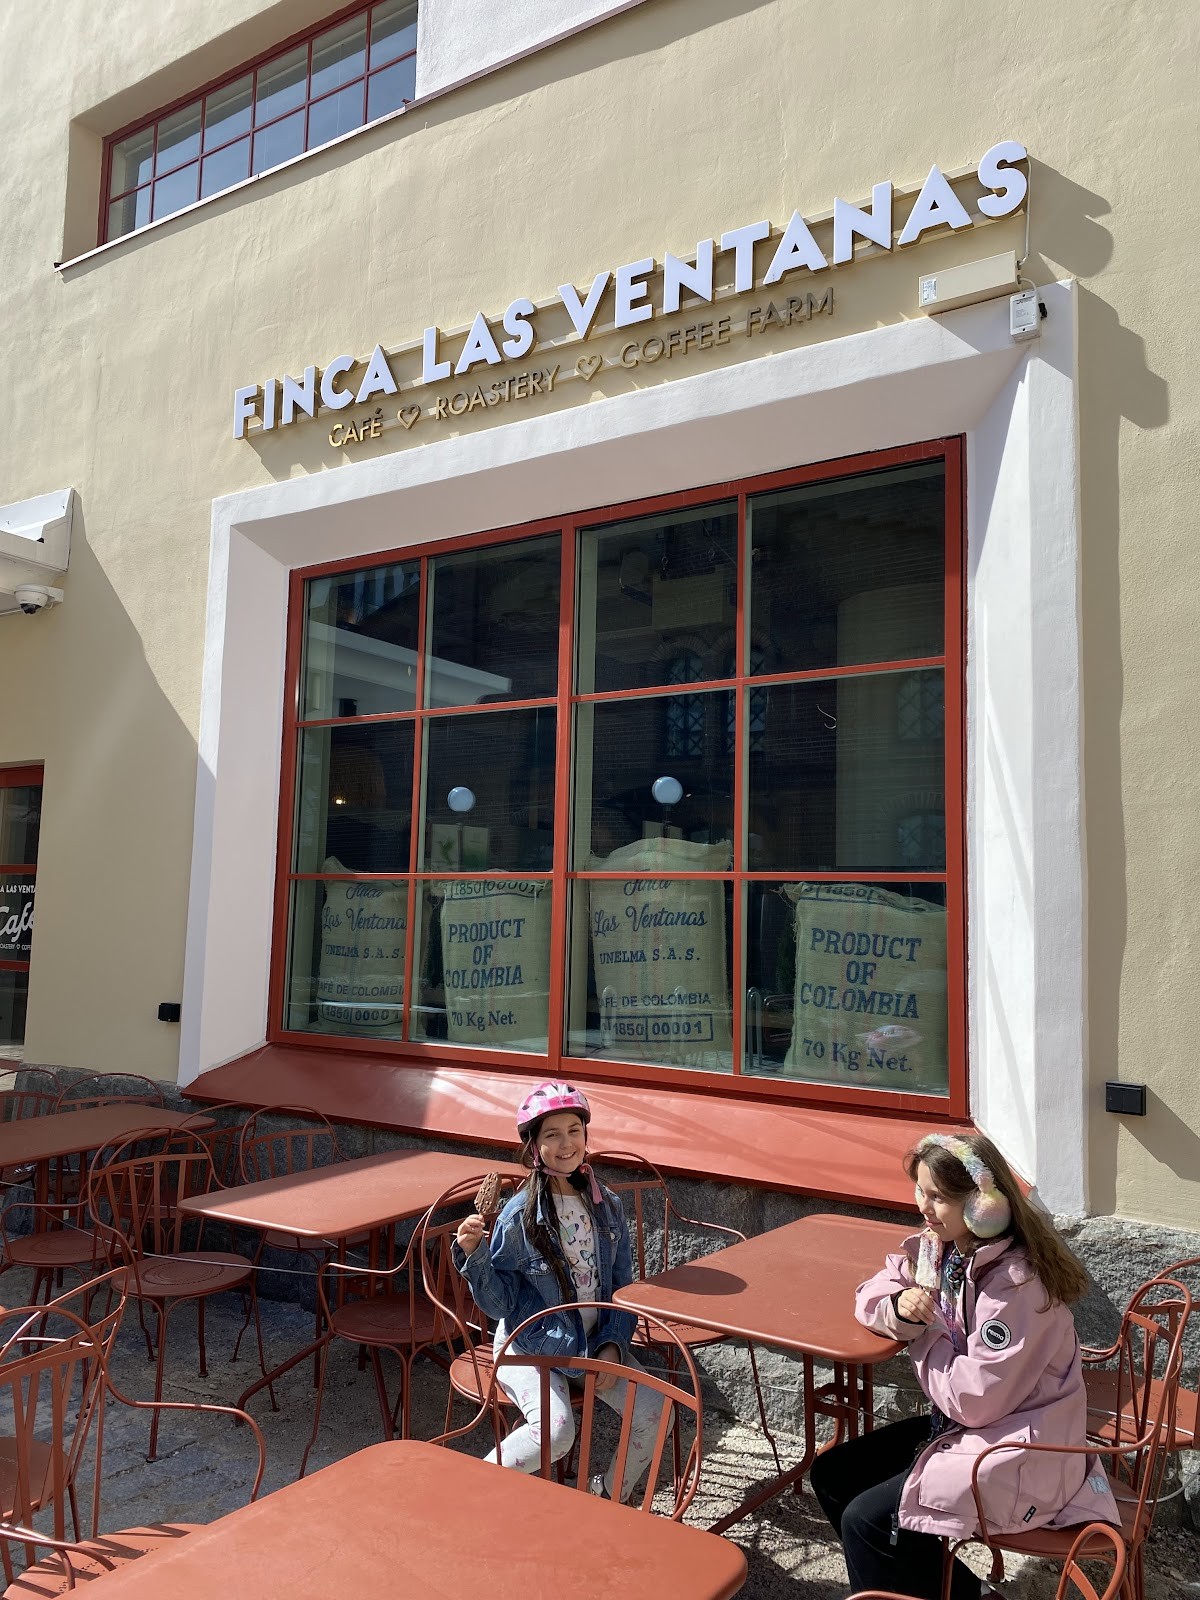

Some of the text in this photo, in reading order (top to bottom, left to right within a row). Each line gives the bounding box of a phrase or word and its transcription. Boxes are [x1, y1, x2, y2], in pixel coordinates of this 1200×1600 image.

[233, 139, 1028, 439] FINCA LAS VENTANAS
[328, 286, 834, 448] CAFÉ ROASTERY COFFEE FARM
[6, 884, 18, 894] LAS
[454, 882, 482, 896] 1850
[323, 906, 407, 931] Las Ventana
[448, 918, 526, 943] PRODUCT
[594, 903, 708, 938] Las Ventanas
[325, 944, 405, 959] UNELMA S.A.S.
[472, 944, 494, 967] OF
[600, 947, 701, 965] UNELMA S.A.S.
[810, 927, 922, 962] PRODUCT
[445, 964, 524, 989] COLOMBIA
[846, 960, 878, 986] OF
[336, 984, 349, 995] DE
[622, 996, 638, 1007] DE
[641, 992, 712, 1007] COLOMBIA
[800, 982, 919, 1019] COLOMBIA
[452, 1010, 518, 1032] 70 Kg Net.
[614, 1022, 645, 1036] 1850
[652, 1020, 702, 1036] 00001
[803, 1038, 912, 1071] 70 Kg Net.
